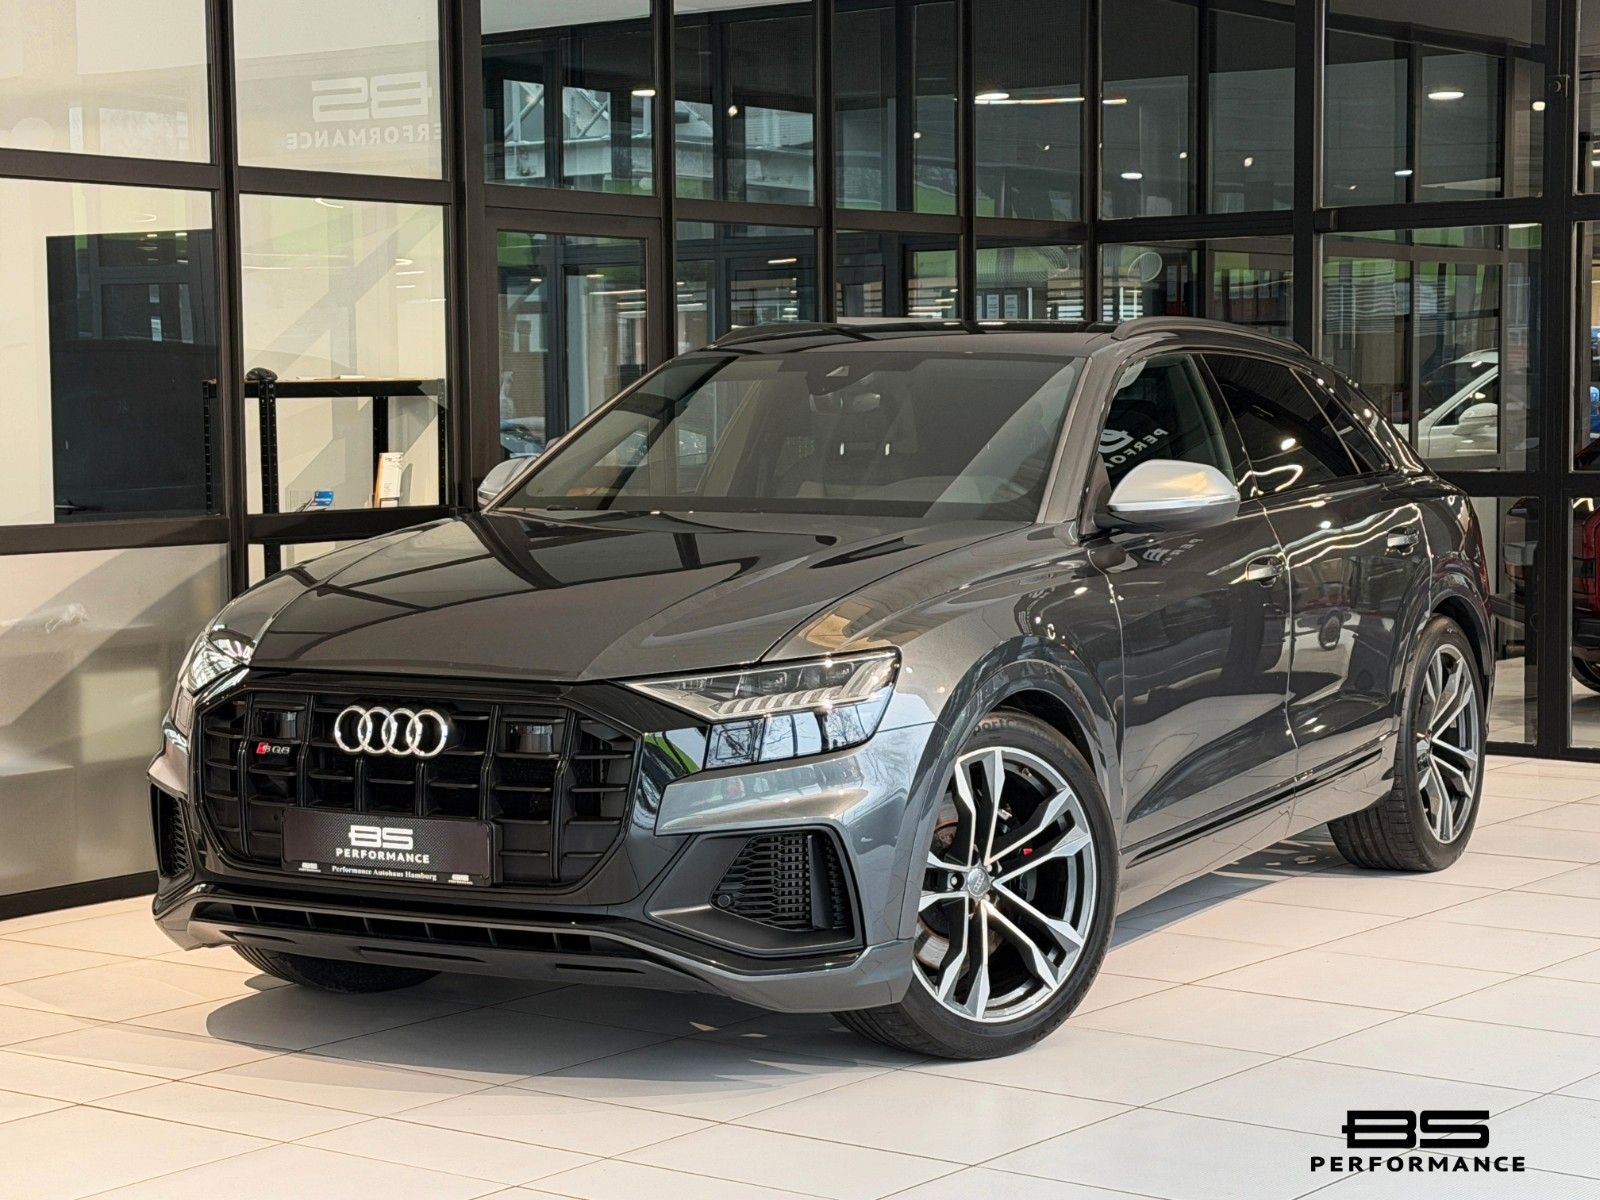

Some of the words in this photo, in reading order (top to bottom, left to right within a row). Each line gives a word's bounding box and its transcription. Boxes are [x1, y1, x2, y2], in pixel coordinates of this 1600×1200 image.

[348, 825, 414, 850] BS
[335, 847, 430, 864] PERFORMANCE
[331, 865, 372, 876] Performance
[373, 868, 404, 878] Autohaus
